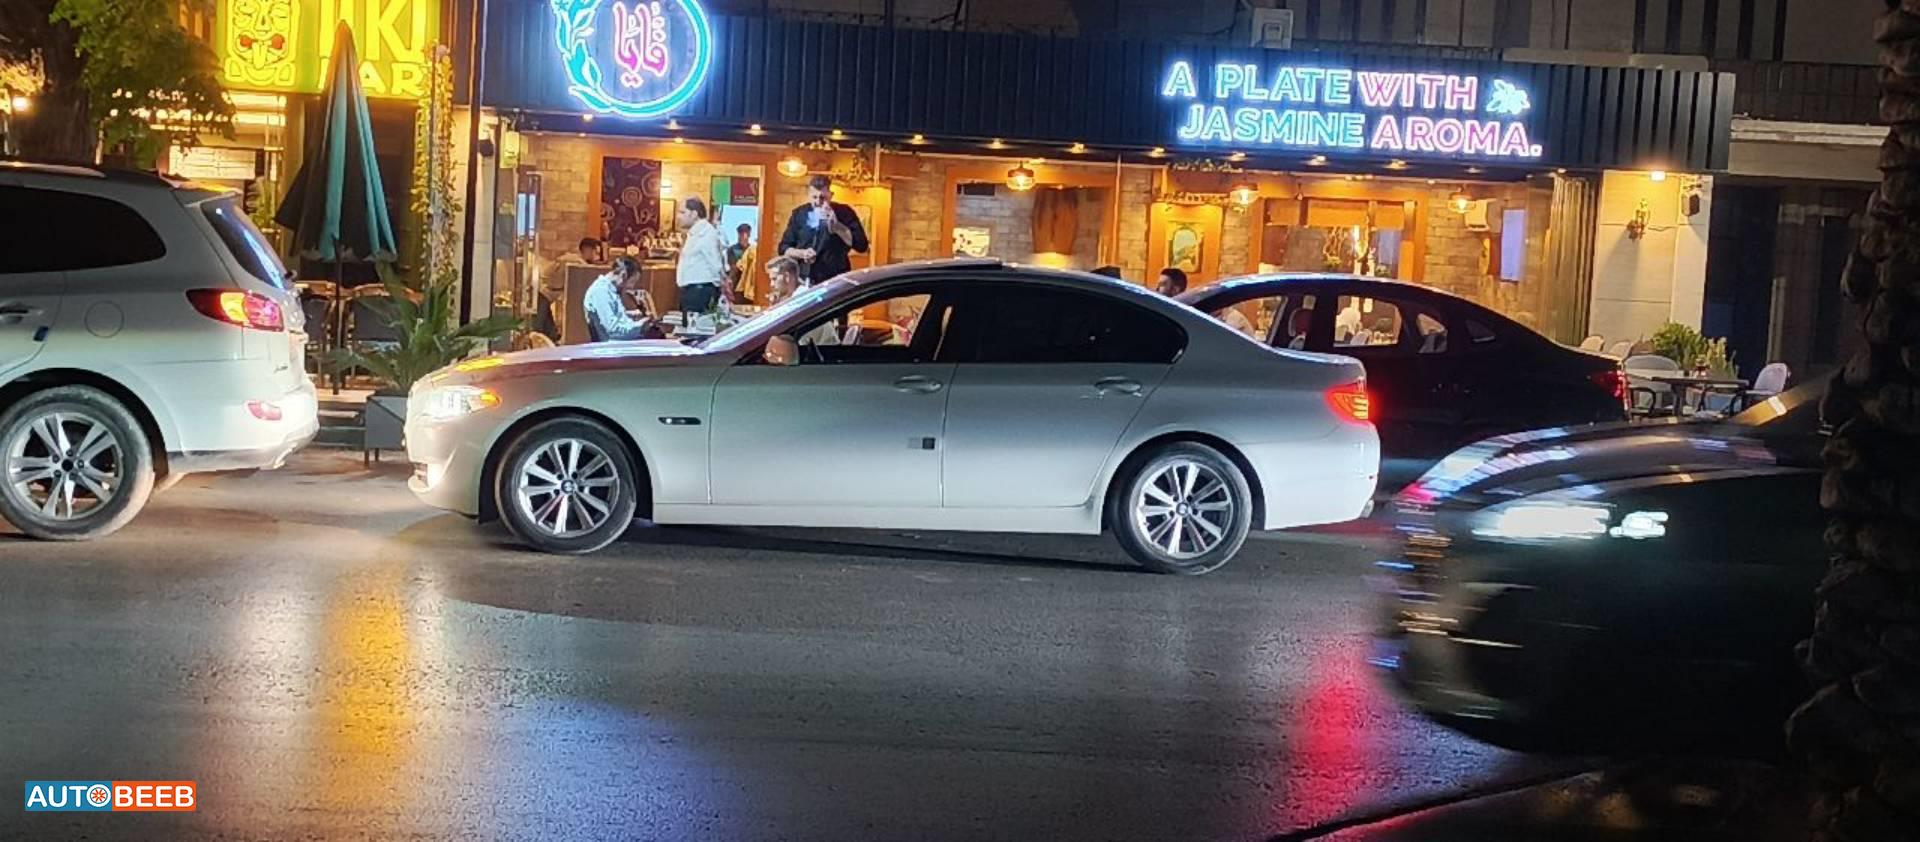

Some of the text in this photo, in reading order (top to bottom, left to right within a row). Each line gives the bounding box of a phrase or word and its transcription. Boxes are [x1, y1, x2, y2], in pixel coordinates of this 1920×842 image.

[317, 58, 429, 97] AR
[1162, 61, 1478, 110] A PLATE WITH
[1177, 104, 1543, 157] JASMINE AROMA.
